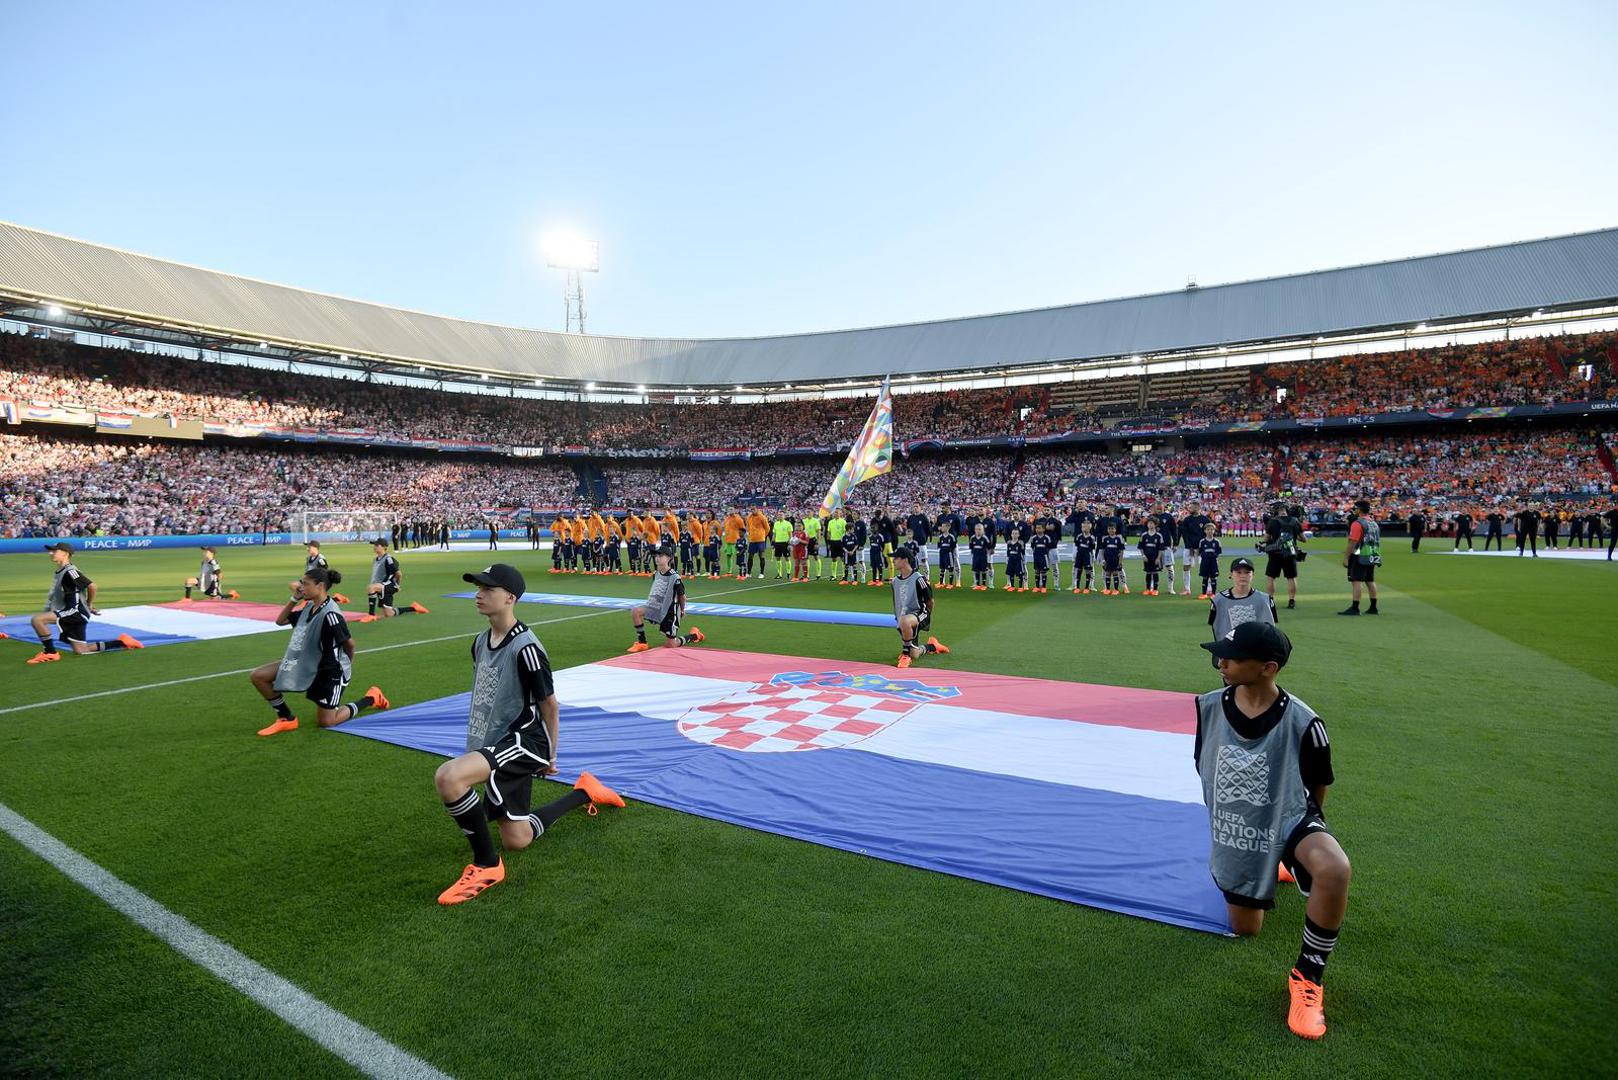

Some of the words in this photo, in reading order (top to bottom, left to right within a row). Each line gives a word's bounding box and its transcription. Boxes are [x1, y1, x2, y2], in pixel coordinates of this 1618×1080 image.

[1348, 416, 1375, 424] FINS
[84, 540, 117, 548] PEACE
[1217, 809, 1247, 826] UEFA
[1213, 819, 1275, 841] NATIONS
[1213, 830, 1270, 853] LEAGUE
